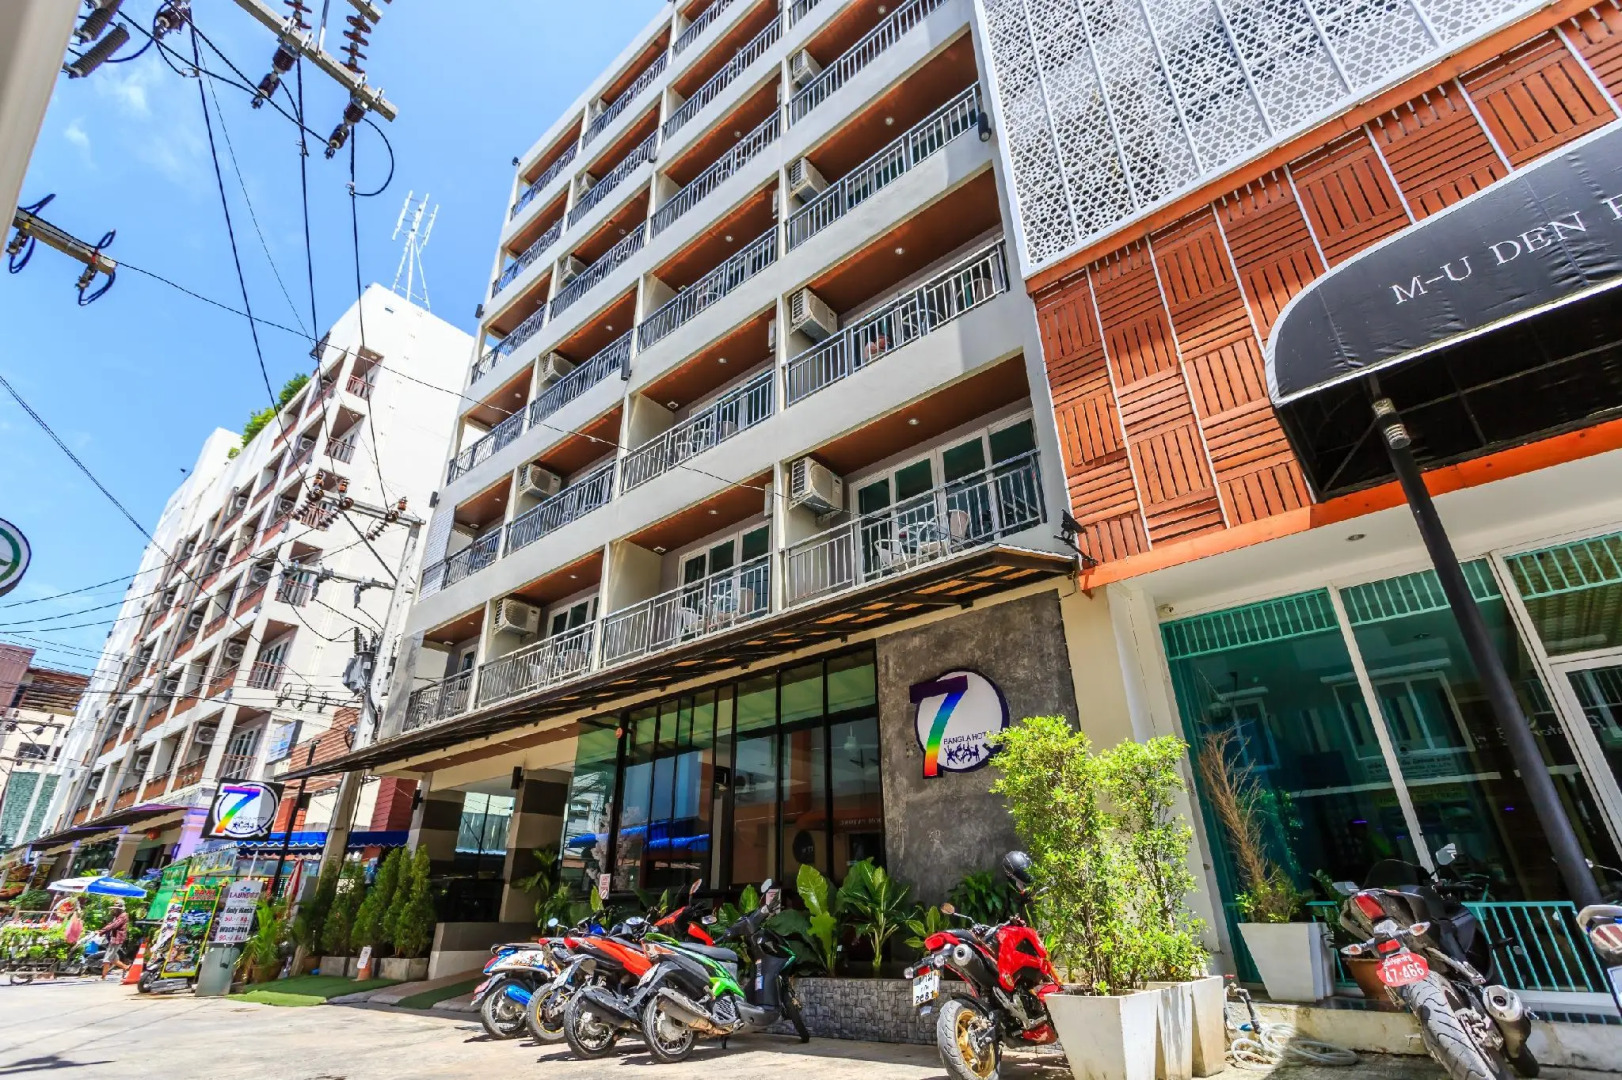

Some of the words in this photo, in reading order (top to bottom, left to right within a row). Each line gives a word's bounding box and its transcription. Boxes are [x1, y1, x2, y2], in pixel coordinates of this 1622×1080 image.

[1389, 256, 1472, 305] M-U
[1488, 211, 1587, 266] DEN
[909, 675, 968, 779] 7
[215, 786, 261, 833] 7
